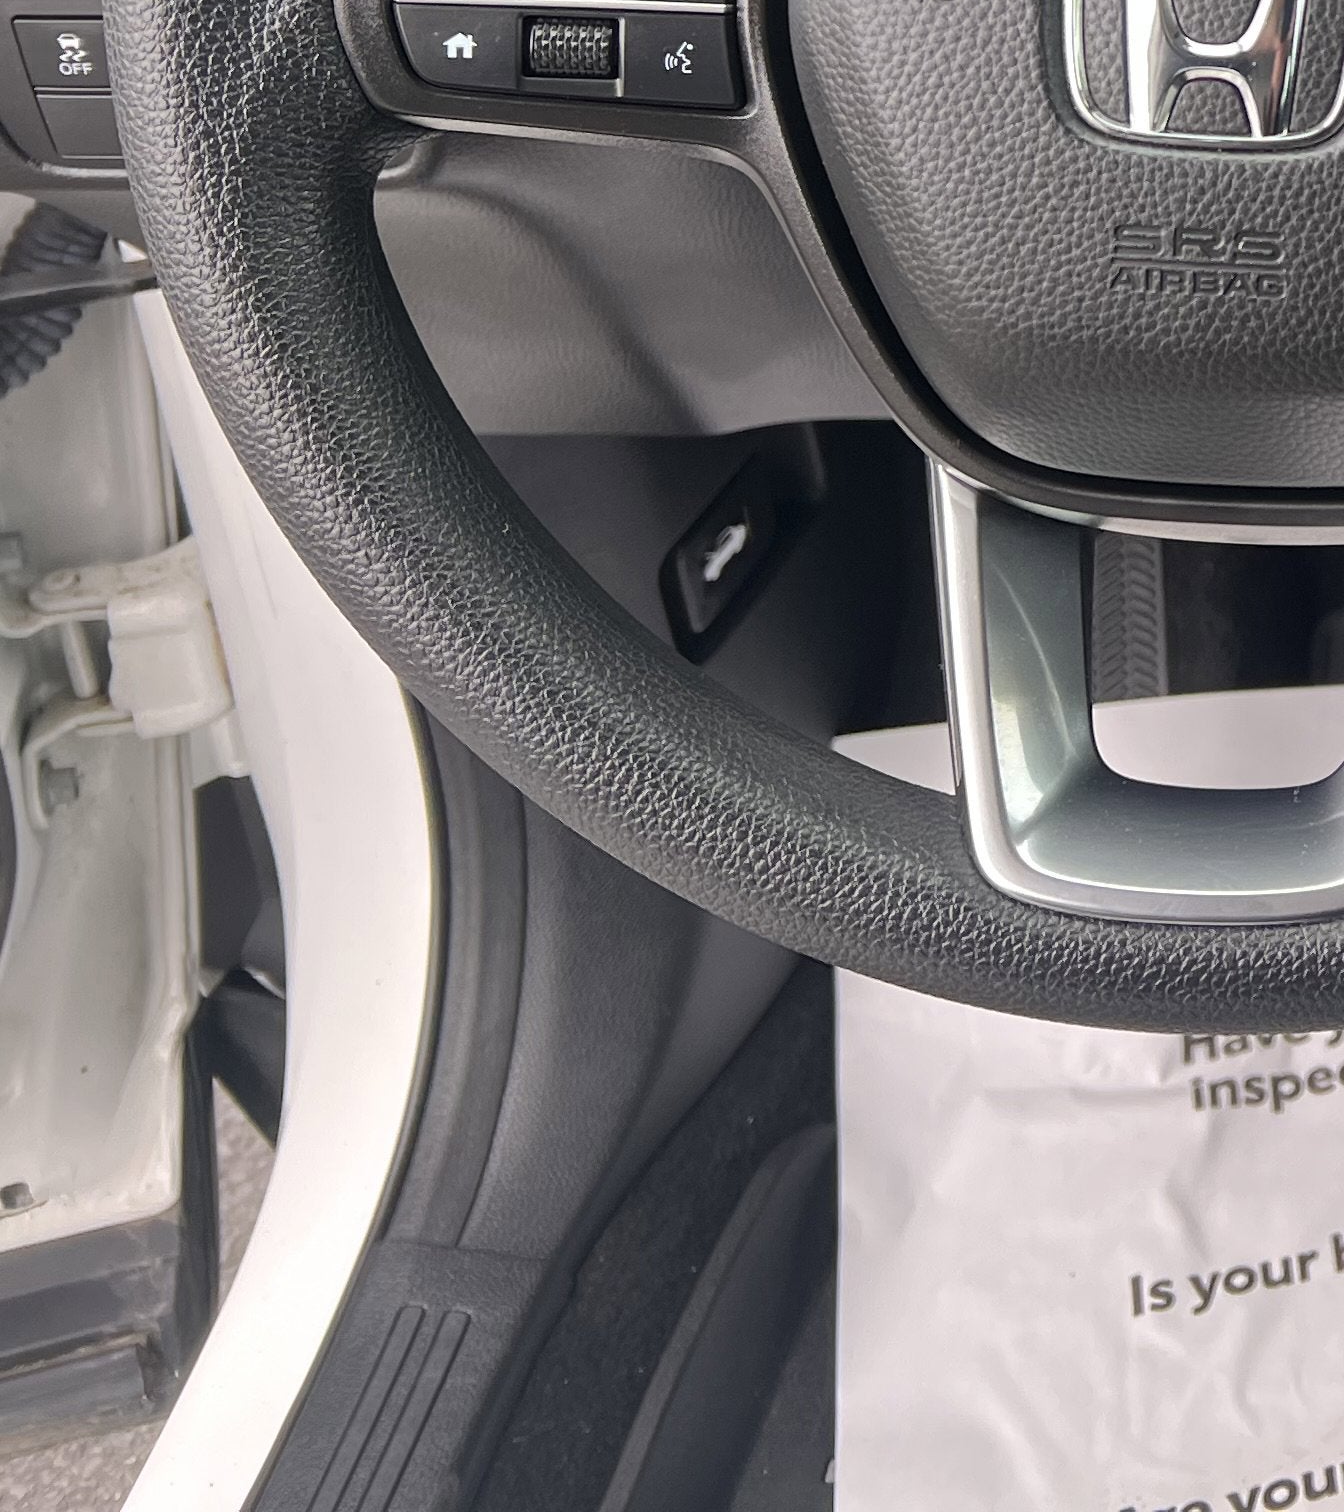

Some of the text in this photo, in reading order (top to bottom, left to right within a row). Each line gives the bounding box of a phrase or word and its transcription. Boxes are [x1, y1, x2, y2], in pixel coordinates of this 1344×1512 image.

[59, 62, 94, 76] OFF
[1112, 224, 1285, 265] SRS
[1110, 268, 1288, 300] AIRBAG
[1130, 1273, 1174, 1316] Is
[1188, 1248, 1317, 1314] your
